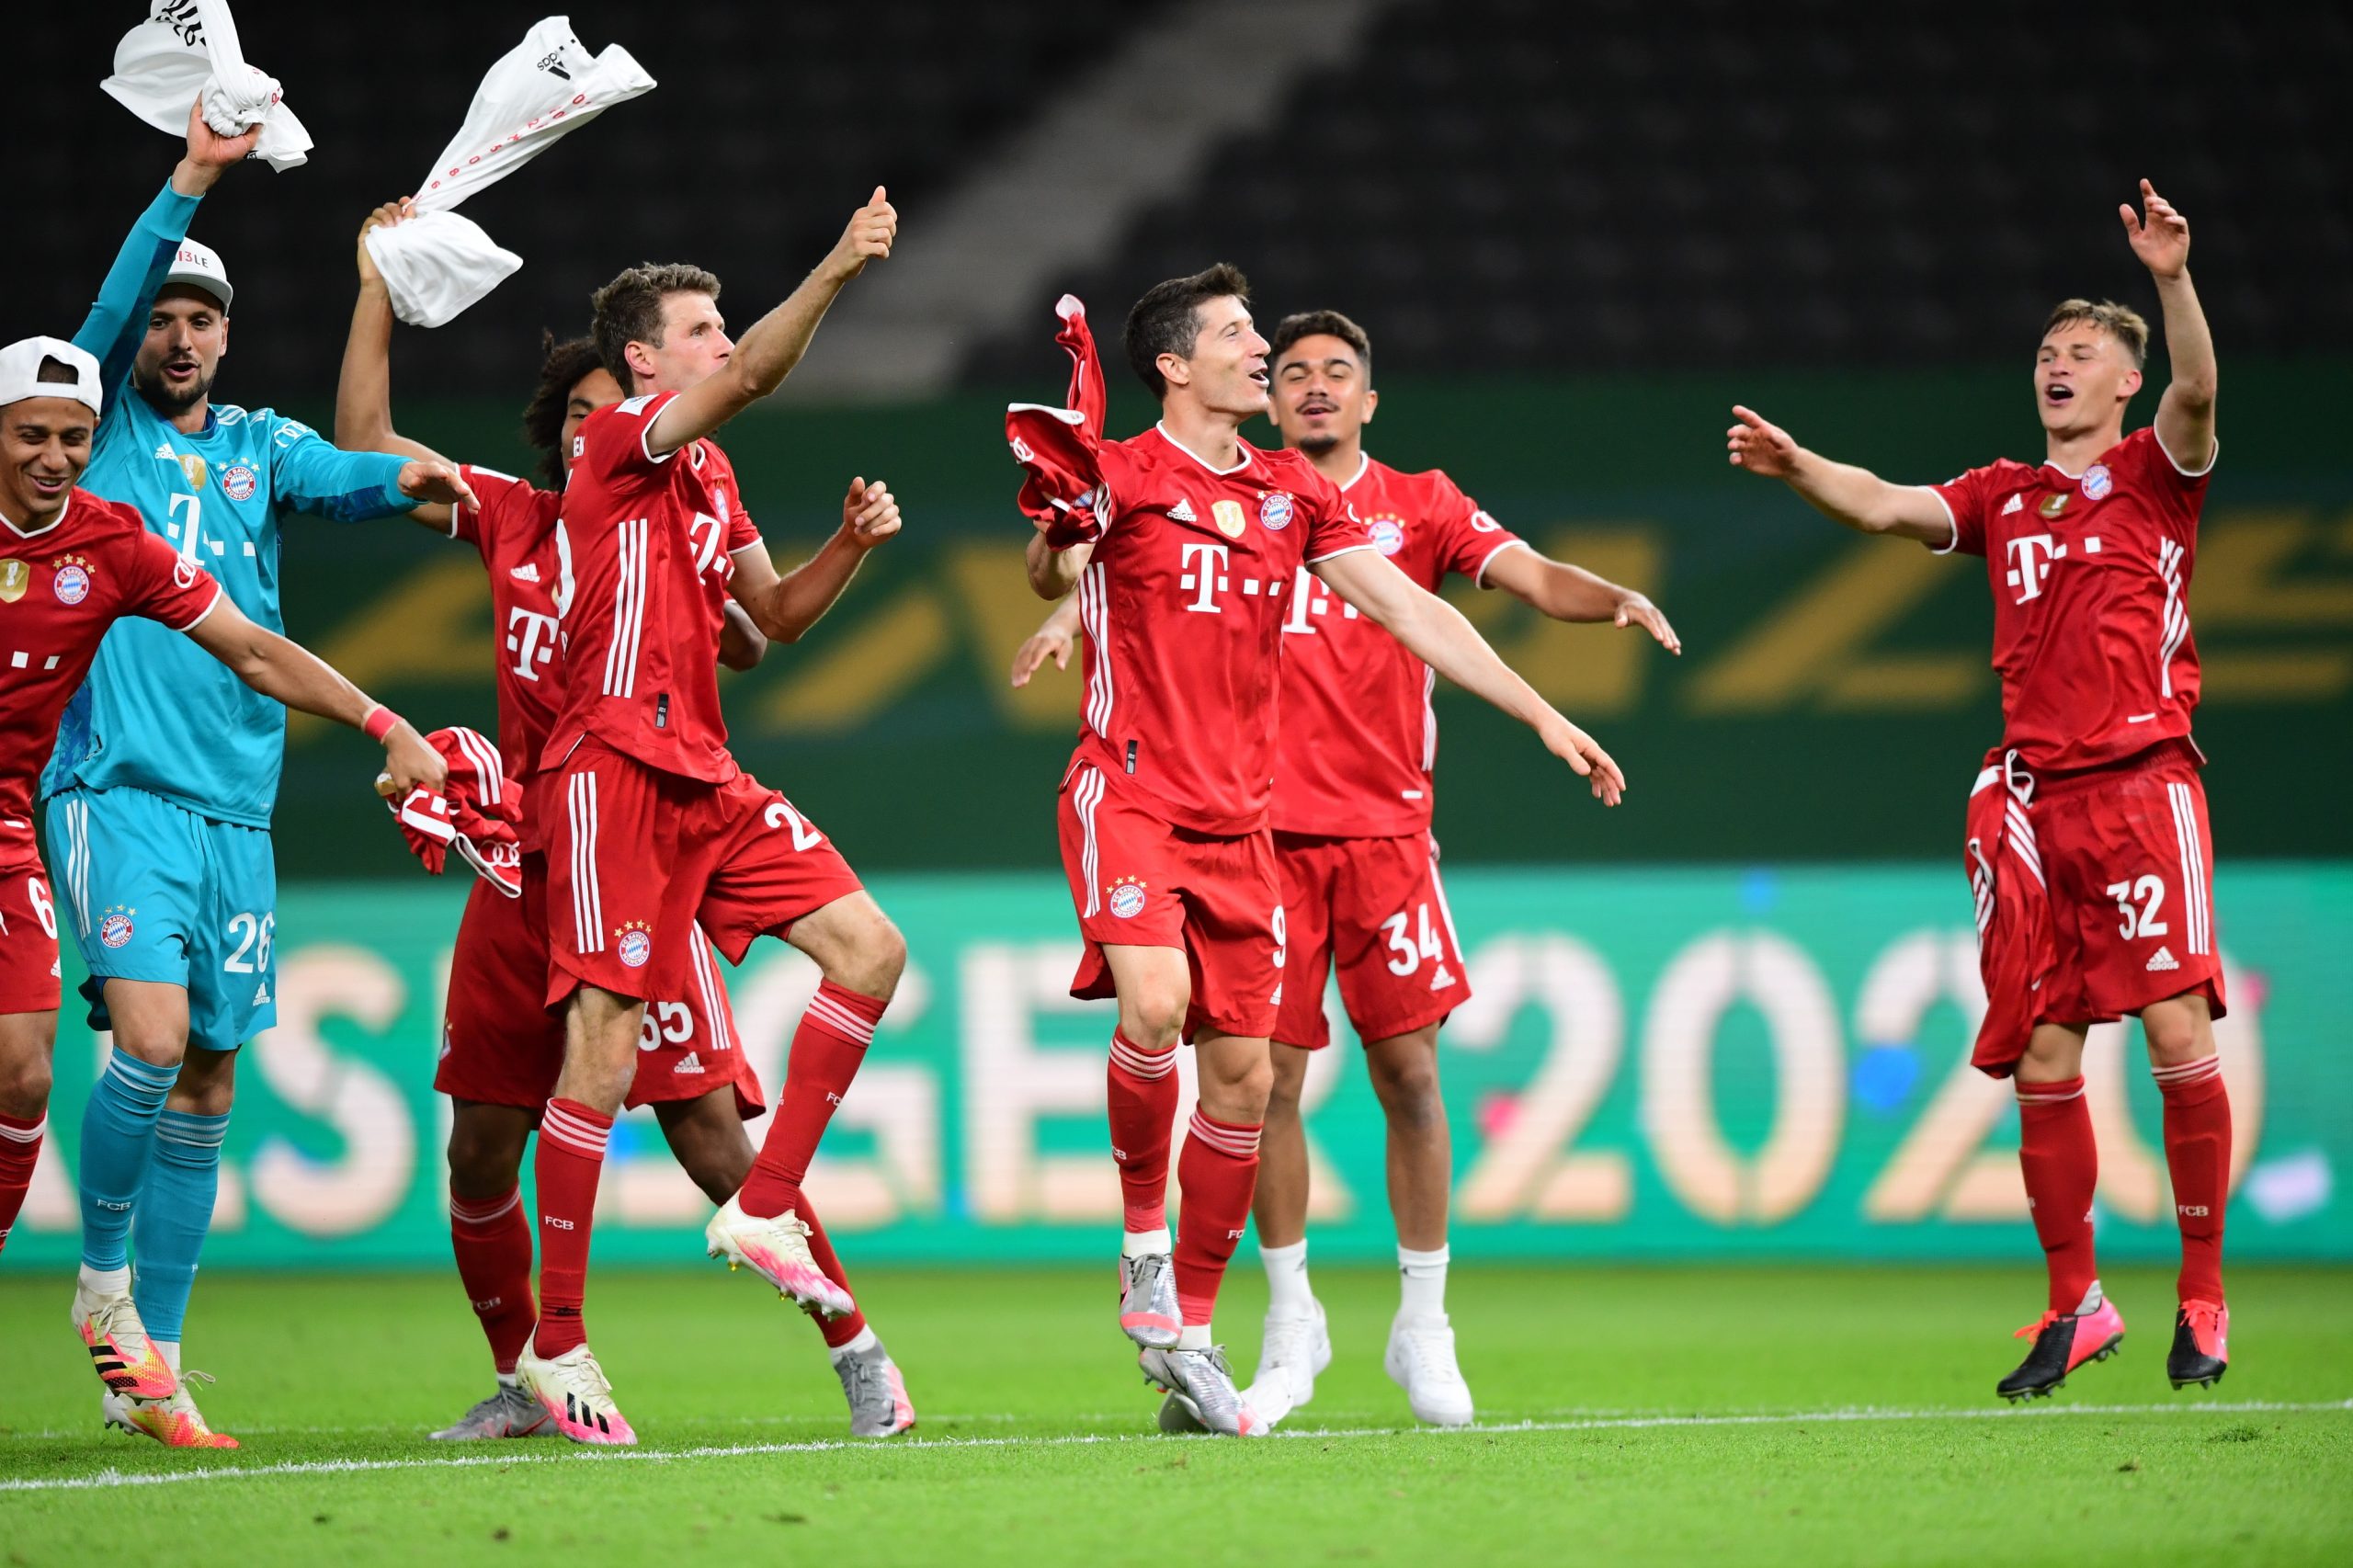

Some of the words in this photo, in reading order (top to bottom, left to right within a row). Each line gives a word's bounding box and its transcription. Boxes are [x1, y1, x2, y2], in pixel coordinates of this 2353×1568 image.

[178, 250, 209, 268] 13LE
[764, 801, 823, 853] 2
[28, 876, 58, 939] 6
[2106, 874, 2168, 941] 32
[223, 911, 275, 973] 26
[1271, 904, 1286, 969] 9
[1380, 902, 1444, 977] 34
[638, 1001, 694, 1051] 35
[674, 1065, 705, 1074] adidas
[1445, 924, 2268, 1230] 2020
[826, 1091, 842, 1107] FC
[97, 1198, 131, 1211] FCB
[545, 1215, 574, 1231] FCB
[2178, 1204, 2209, 1217] FCB
